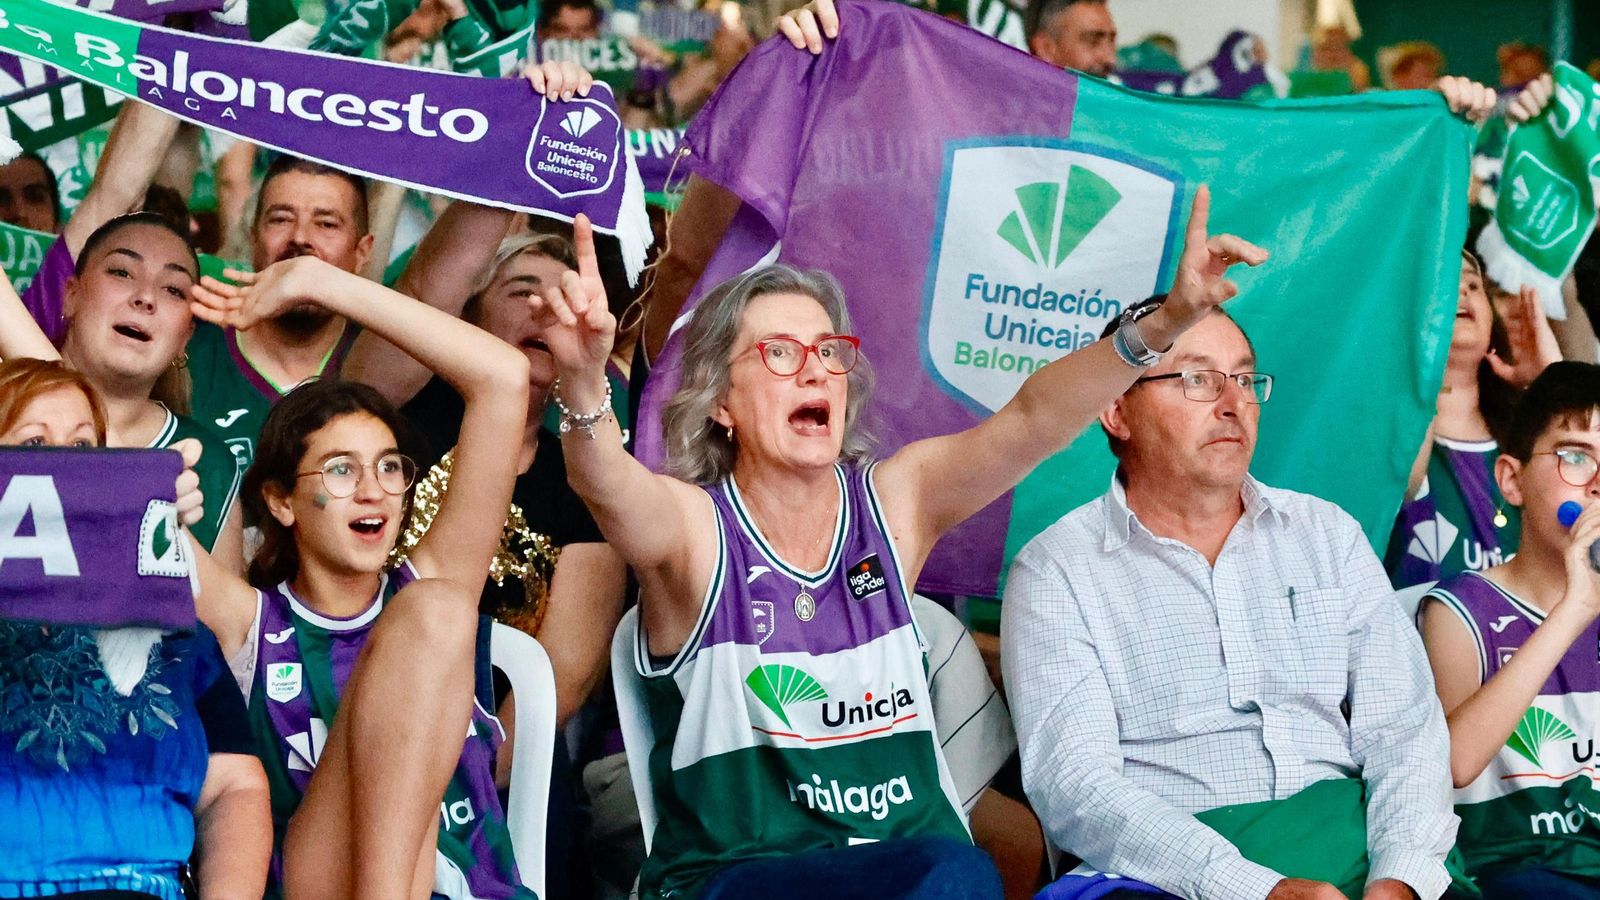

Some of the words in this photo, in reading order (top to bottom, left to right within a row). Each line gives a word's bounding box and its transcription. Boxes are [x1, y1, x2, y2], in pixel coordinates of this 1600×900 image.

[73, 31, 489, 142] Baloncesto
[540, 135, 607, 163] Fundación
[547, 151, 595, 173] Unicaja
[537, 161, 598, 184] Baloncesto
[964, 273, 1121, 318] Fundación
[984, 313, 1096, 352] Unicaja
[850, 571, 871, 586] liga
